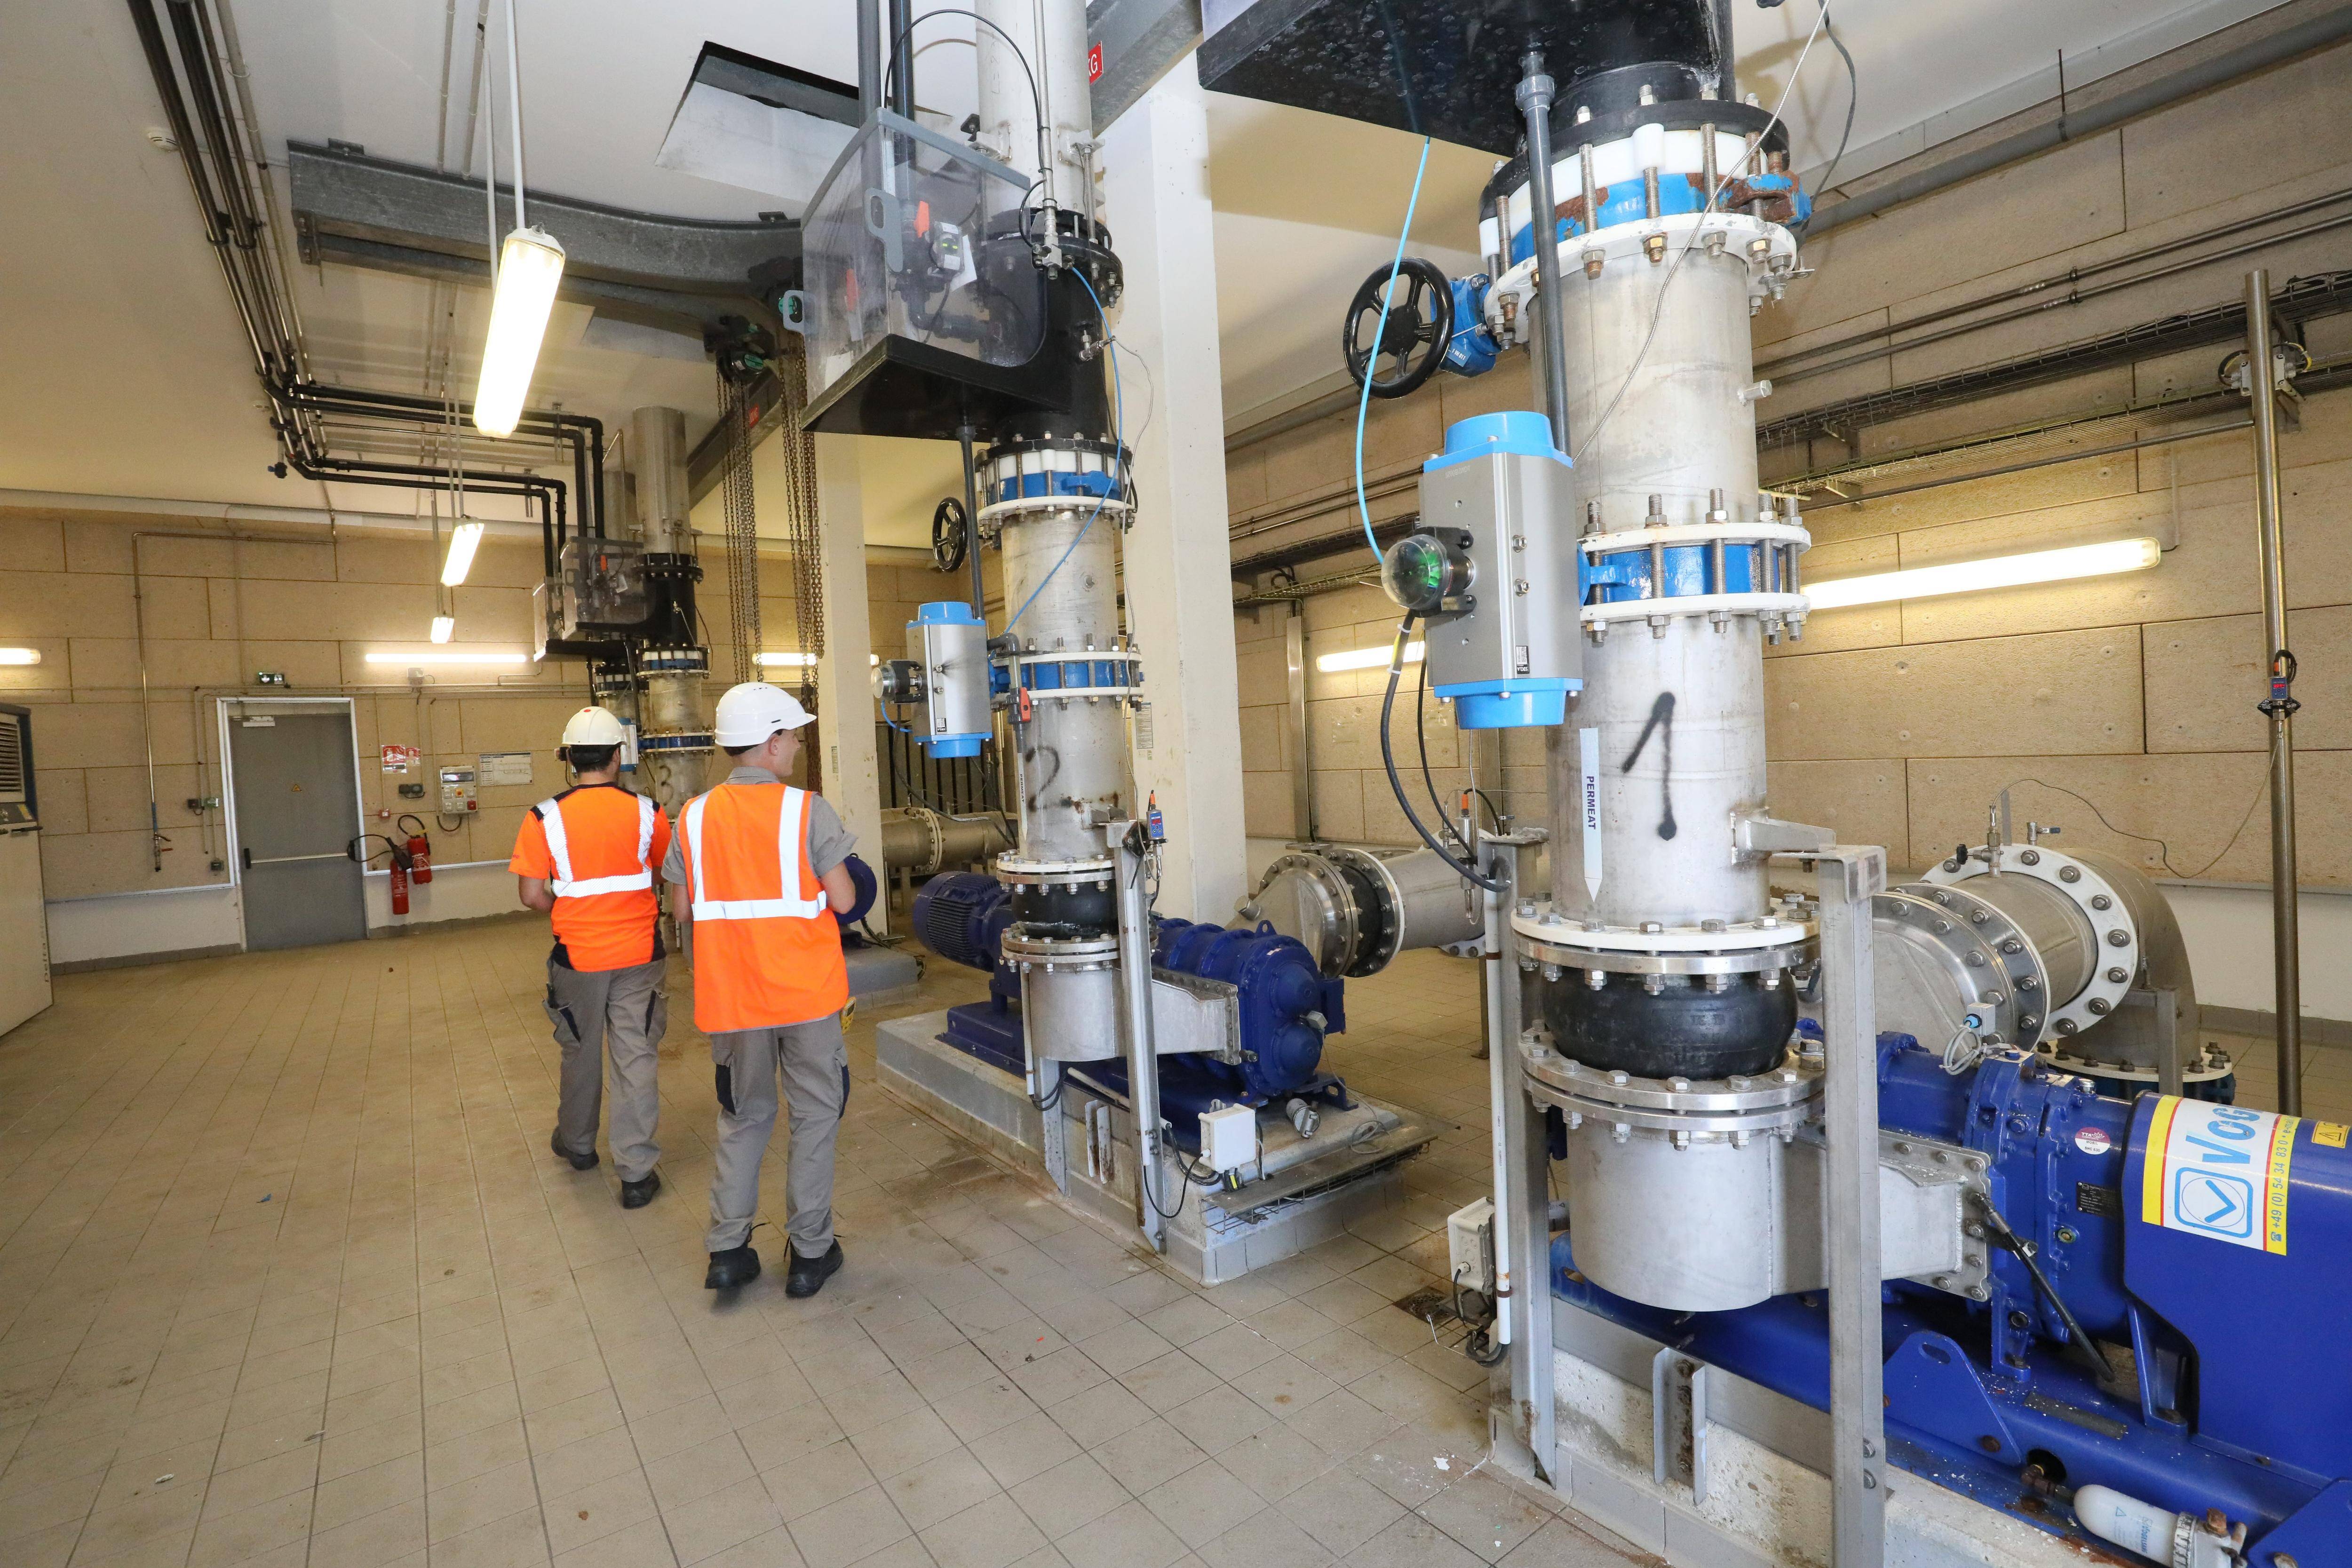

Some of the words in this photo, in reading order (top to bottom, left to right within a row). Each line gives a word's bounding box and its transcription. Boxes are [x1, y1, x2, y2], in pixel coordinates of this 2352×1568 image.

[1025, 745, 1072, 812] 2
[1622, 692, 1677, 841] 1
[659, 764, 674, 806] 3
[1587, 776, 1596, 829] PERMEAT
[2273, 1177, 2283, 1189] 54
[2274, 1163, 2285, 1174] 34
[2272, 1193, 2285, 1207] (0)
[2271, 1210, 2282, 1228] +49
